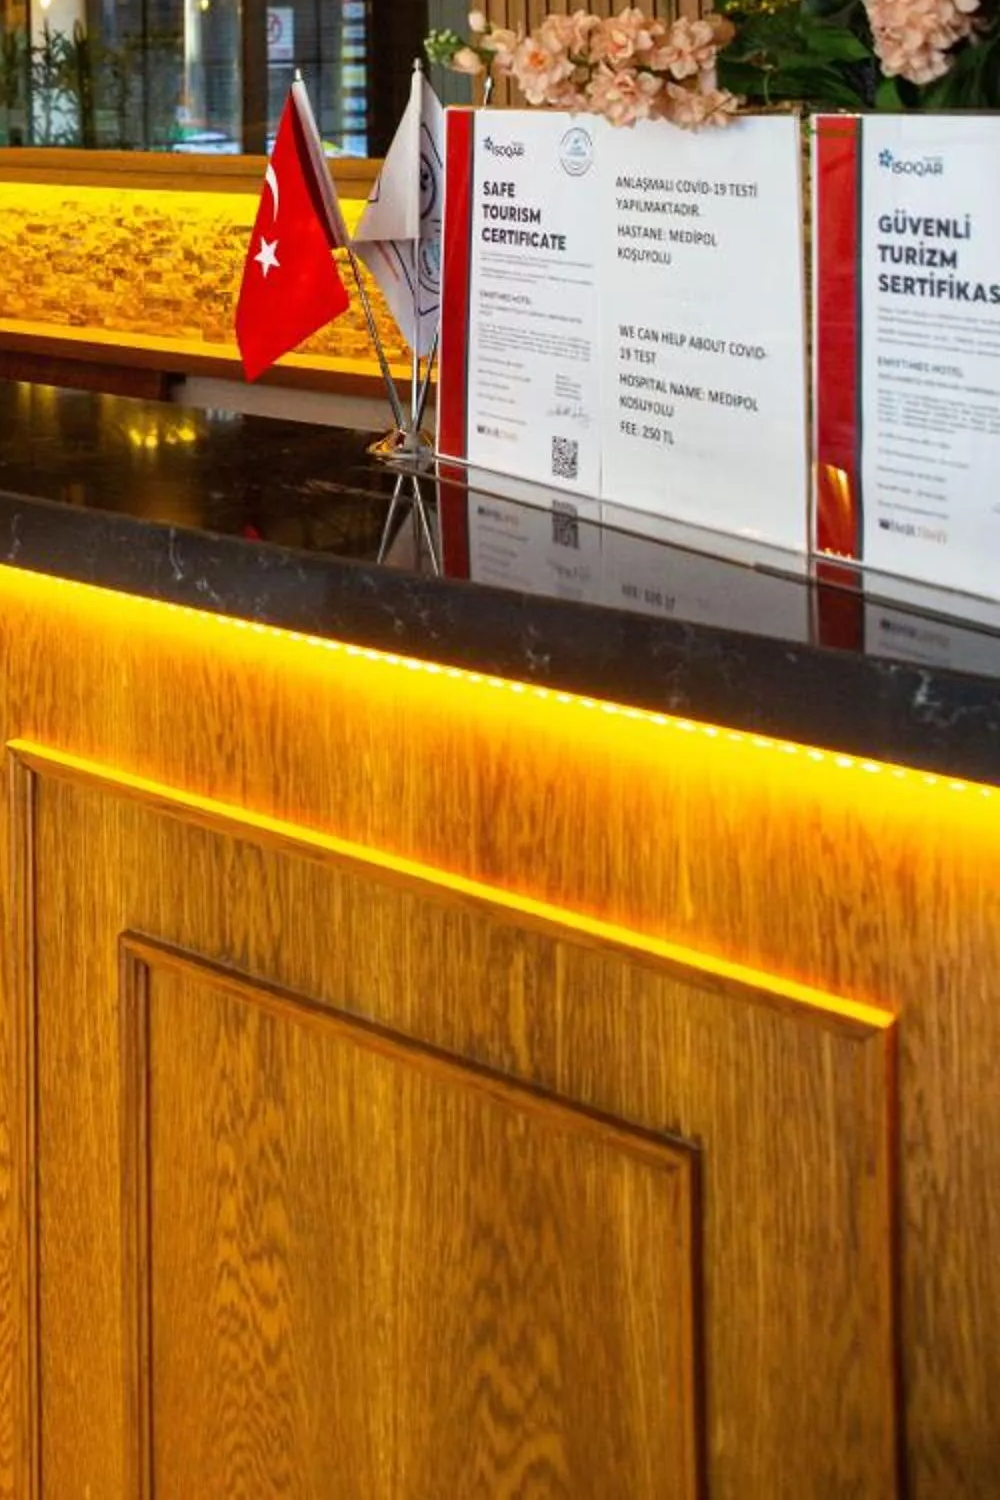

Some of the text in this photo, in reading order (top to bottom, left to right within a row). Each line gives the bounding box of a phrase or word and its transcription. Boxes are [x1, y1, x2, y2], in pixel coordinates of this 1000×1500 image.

[892, 161, 943, 176] ISOQAR
[483, 180, 515, 198] SAFE
[481, 203, 542, 225] TOURISM
[877, 208, 971, 239] GÜVENLİ
[481, 227, 567, 251] CERTIFICATE
[877, 240, 958, 269] TURİZM
[618, 324, 635, 339] WE
[637, 327, 659, 344] CAN
[661, 331, 687, 348] HELP
[688, 336, 727, 354] ABOUT
[633, 349, 657, 365] TEST
[618, 373, 668, 394] HOSPITAL
[641, 424, 661, 443] 250
[663, 429, 676, 446] TL
